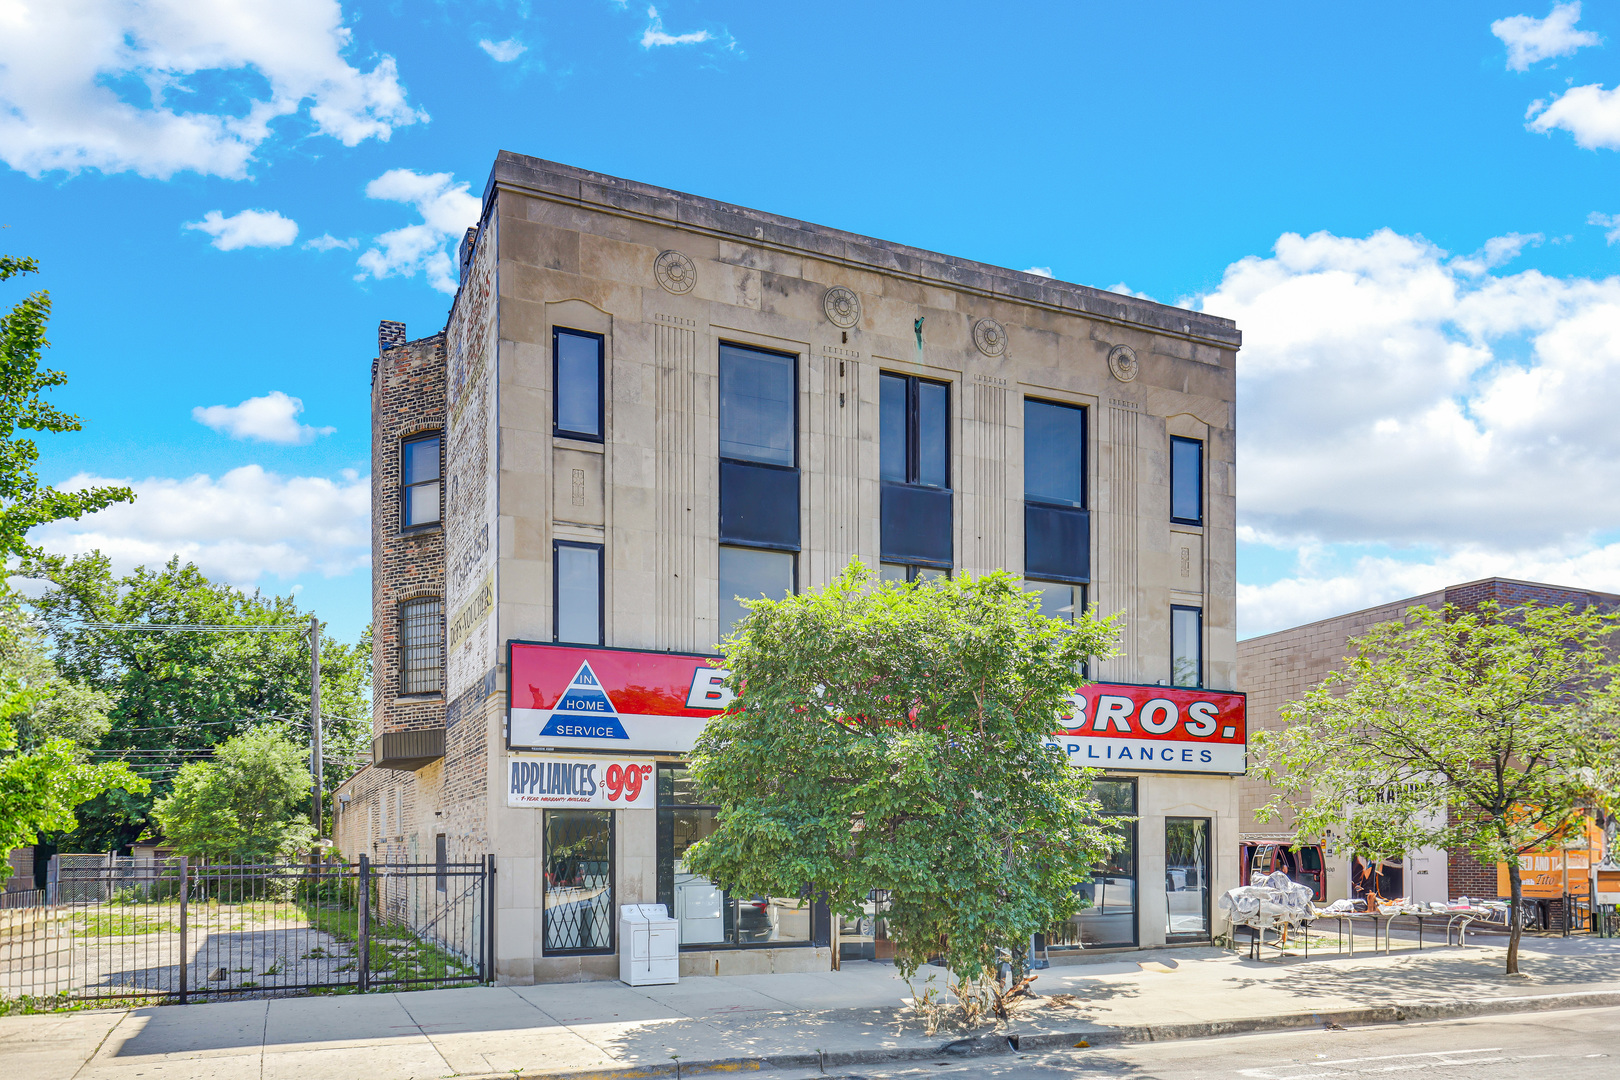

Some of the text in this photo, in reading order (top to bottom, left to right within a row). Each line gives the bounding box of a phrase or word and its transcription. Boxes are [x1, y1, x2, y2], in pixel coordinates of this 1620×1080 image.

[579, 674, 593, 685] IN
[566, 699, 605, 711] HOME
[1057, 692, 1237, 739] BROS.
[556, 725, 614, 737] SERVICE
[1045, 742, 1213, 763] PPLIANCES
[510, 761, 597, 796] APPLIANCES
[1534, 856, 1550, 871] AND
